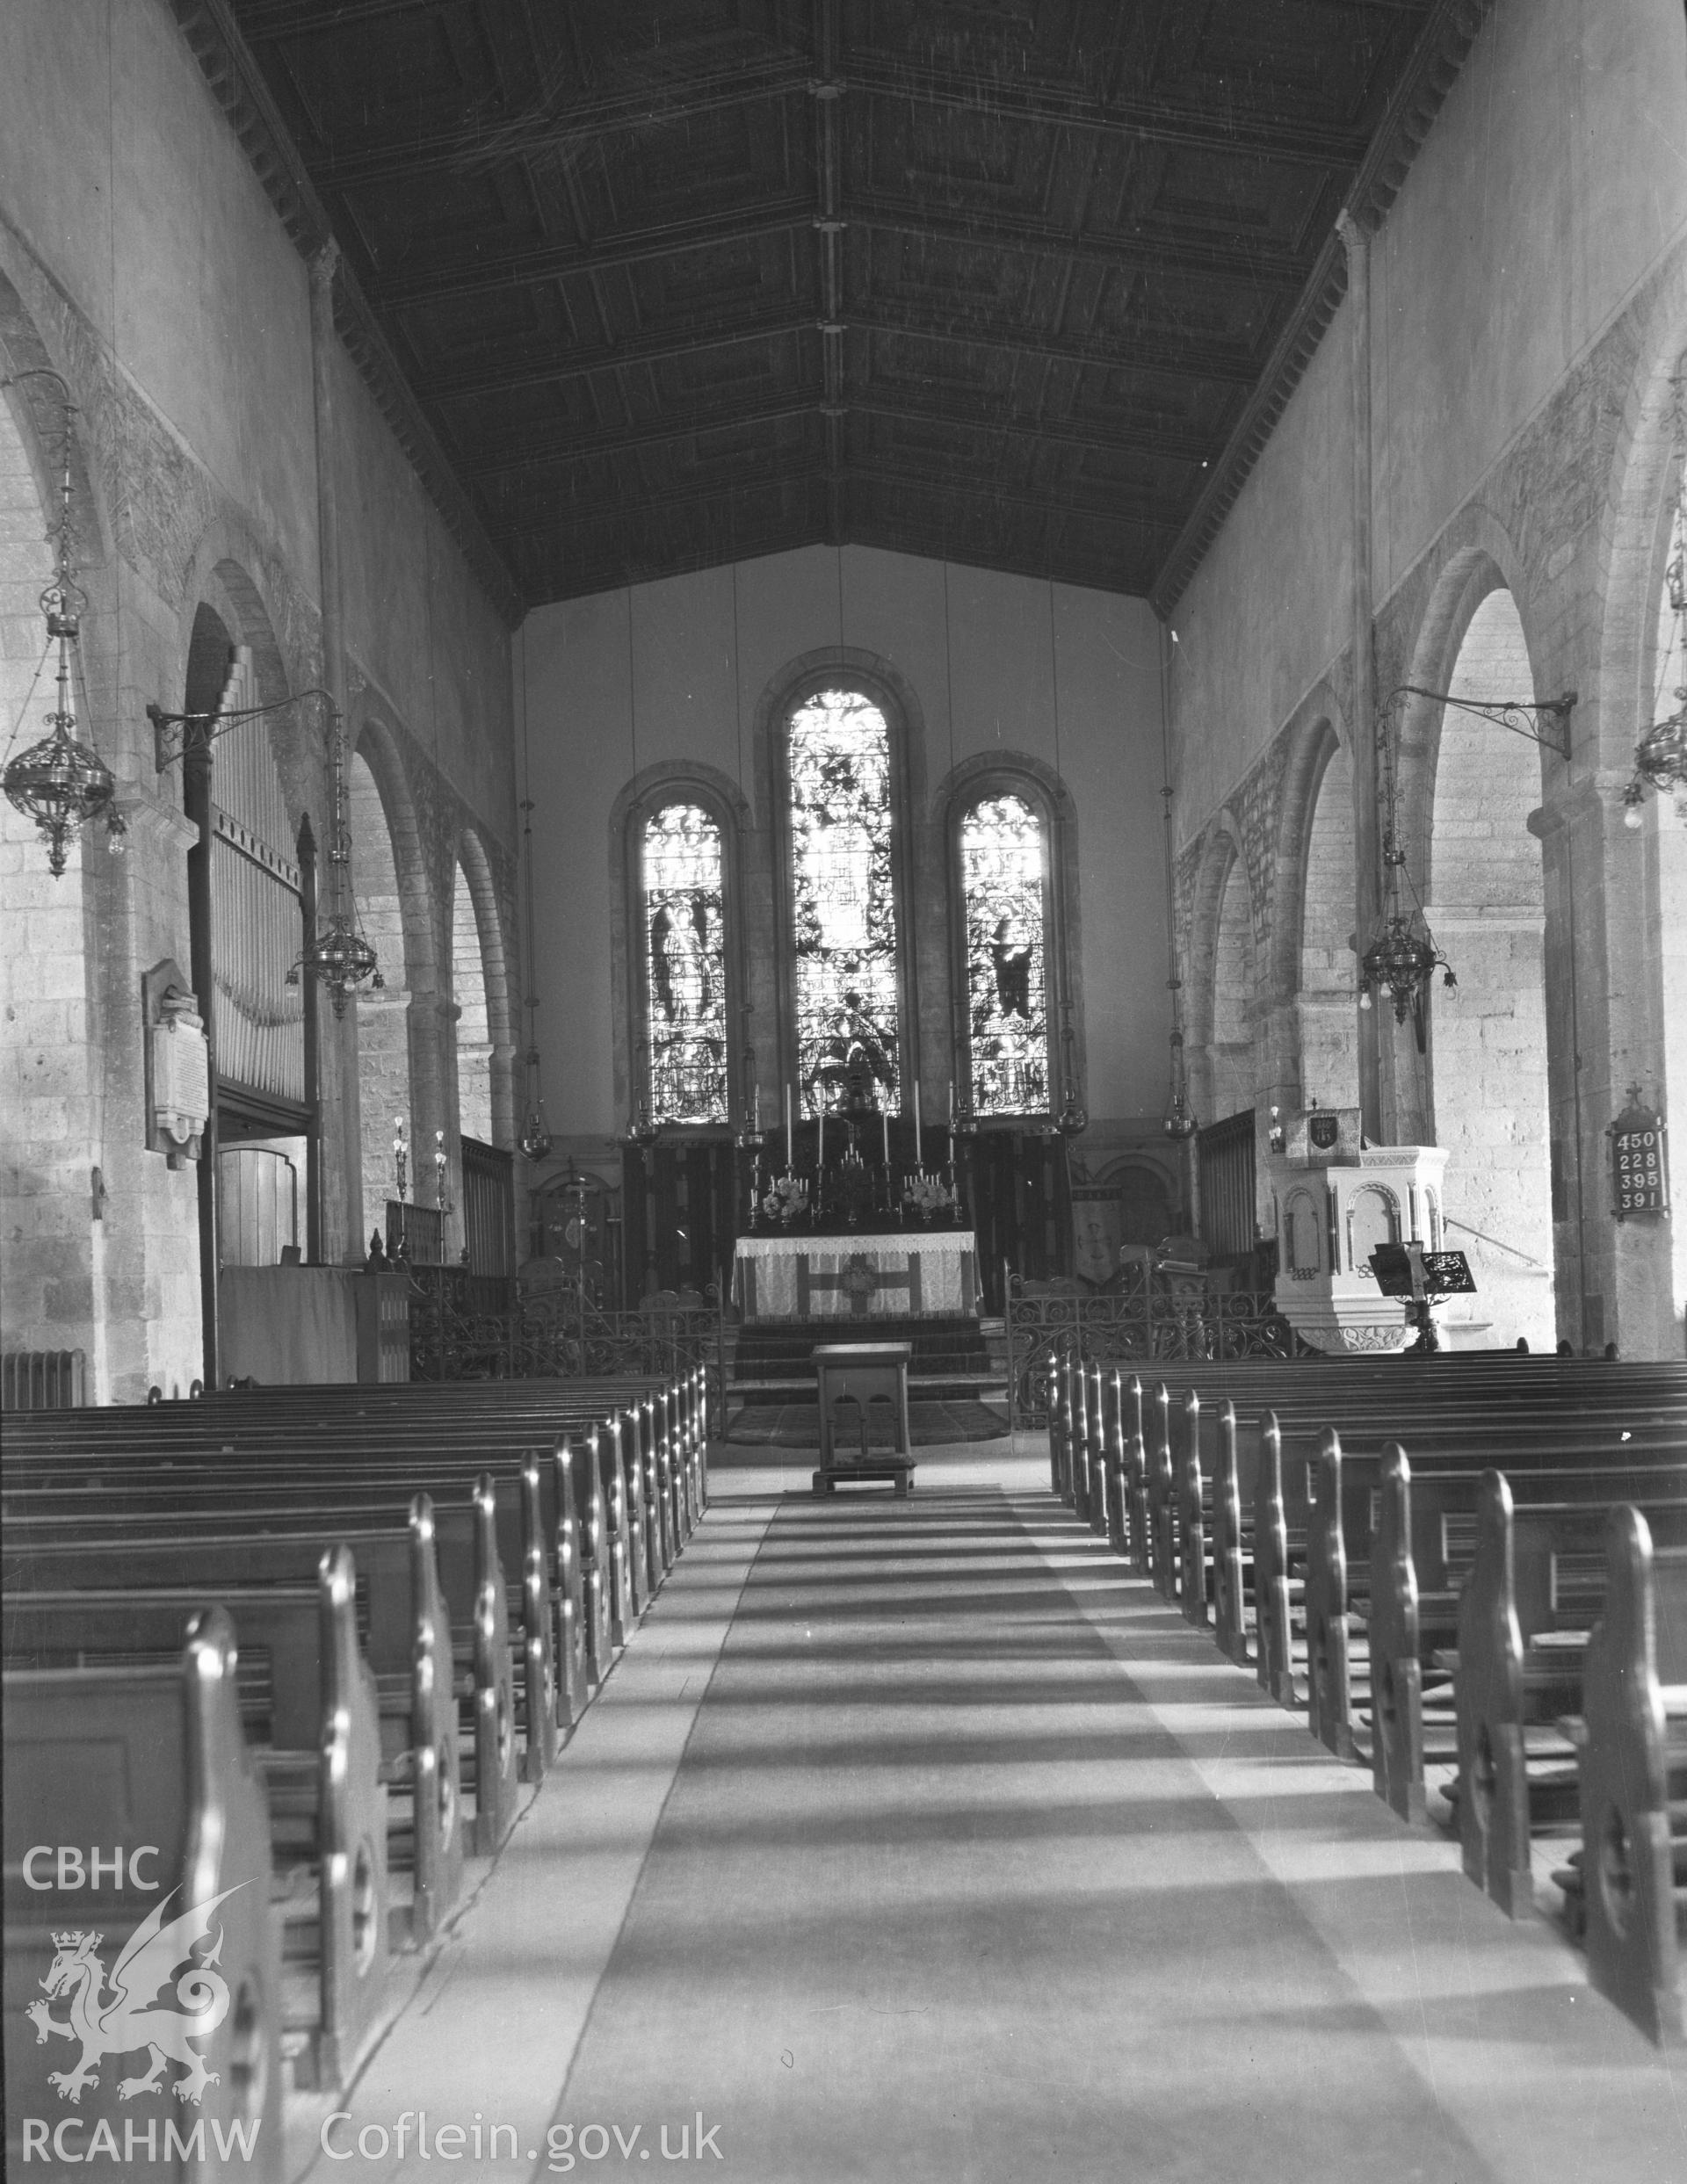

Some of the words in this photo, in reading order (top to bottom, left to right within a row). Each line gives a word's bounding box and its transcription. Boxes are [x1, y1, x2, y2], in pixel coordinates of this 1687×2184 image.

[1617, 1132, 1654, 1151] 450
[1619, 1153, 1656, 1170] 228
[1621, 1171, 1658, 1190] 395
[1622, 1192, 1655, 1209] 391
